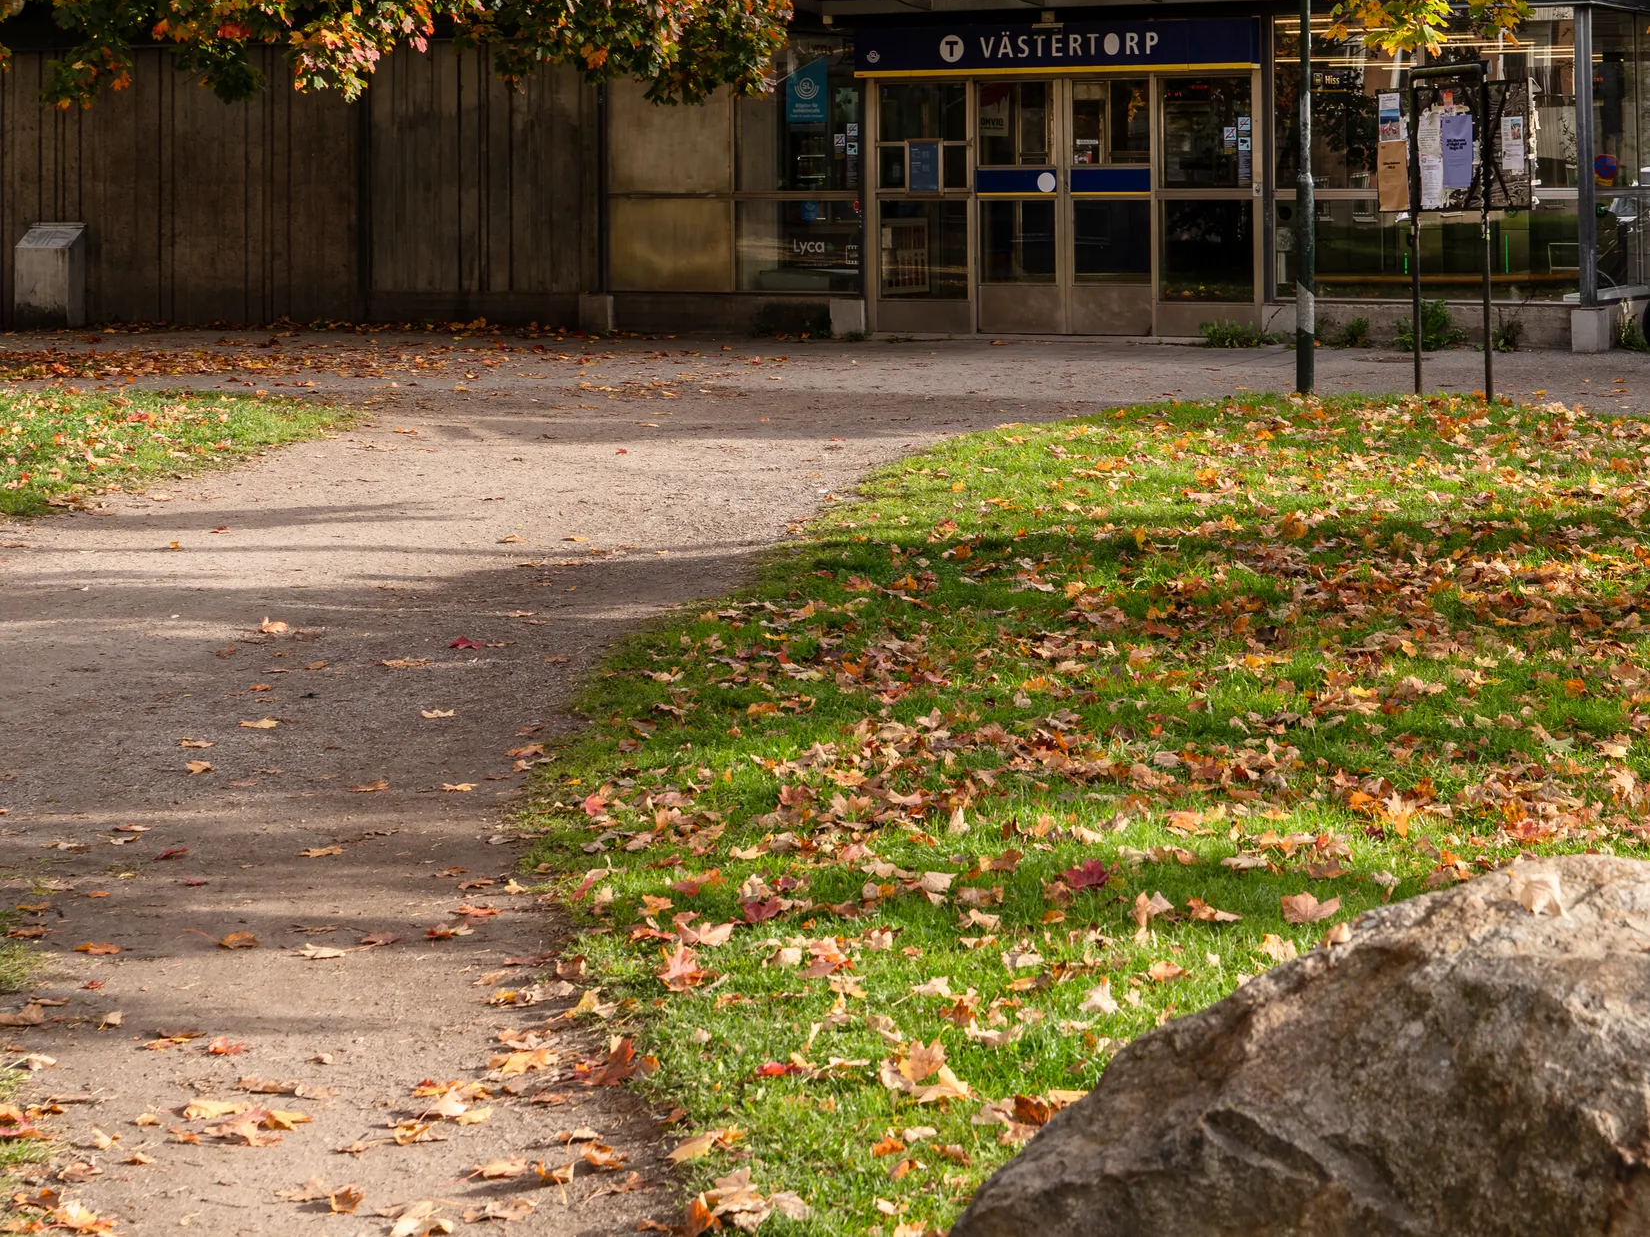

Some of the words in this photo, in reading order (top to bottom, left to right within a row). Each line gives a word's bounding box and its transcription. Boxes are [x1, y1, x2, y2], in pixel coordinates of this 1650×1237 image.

[979, 31, 1159, 58] VÄSTERTORP
[802, 82, 811, 90] SL
[1325, 75, 1341, 85] Hiss
[793, 238, 825, 255] Lyca
